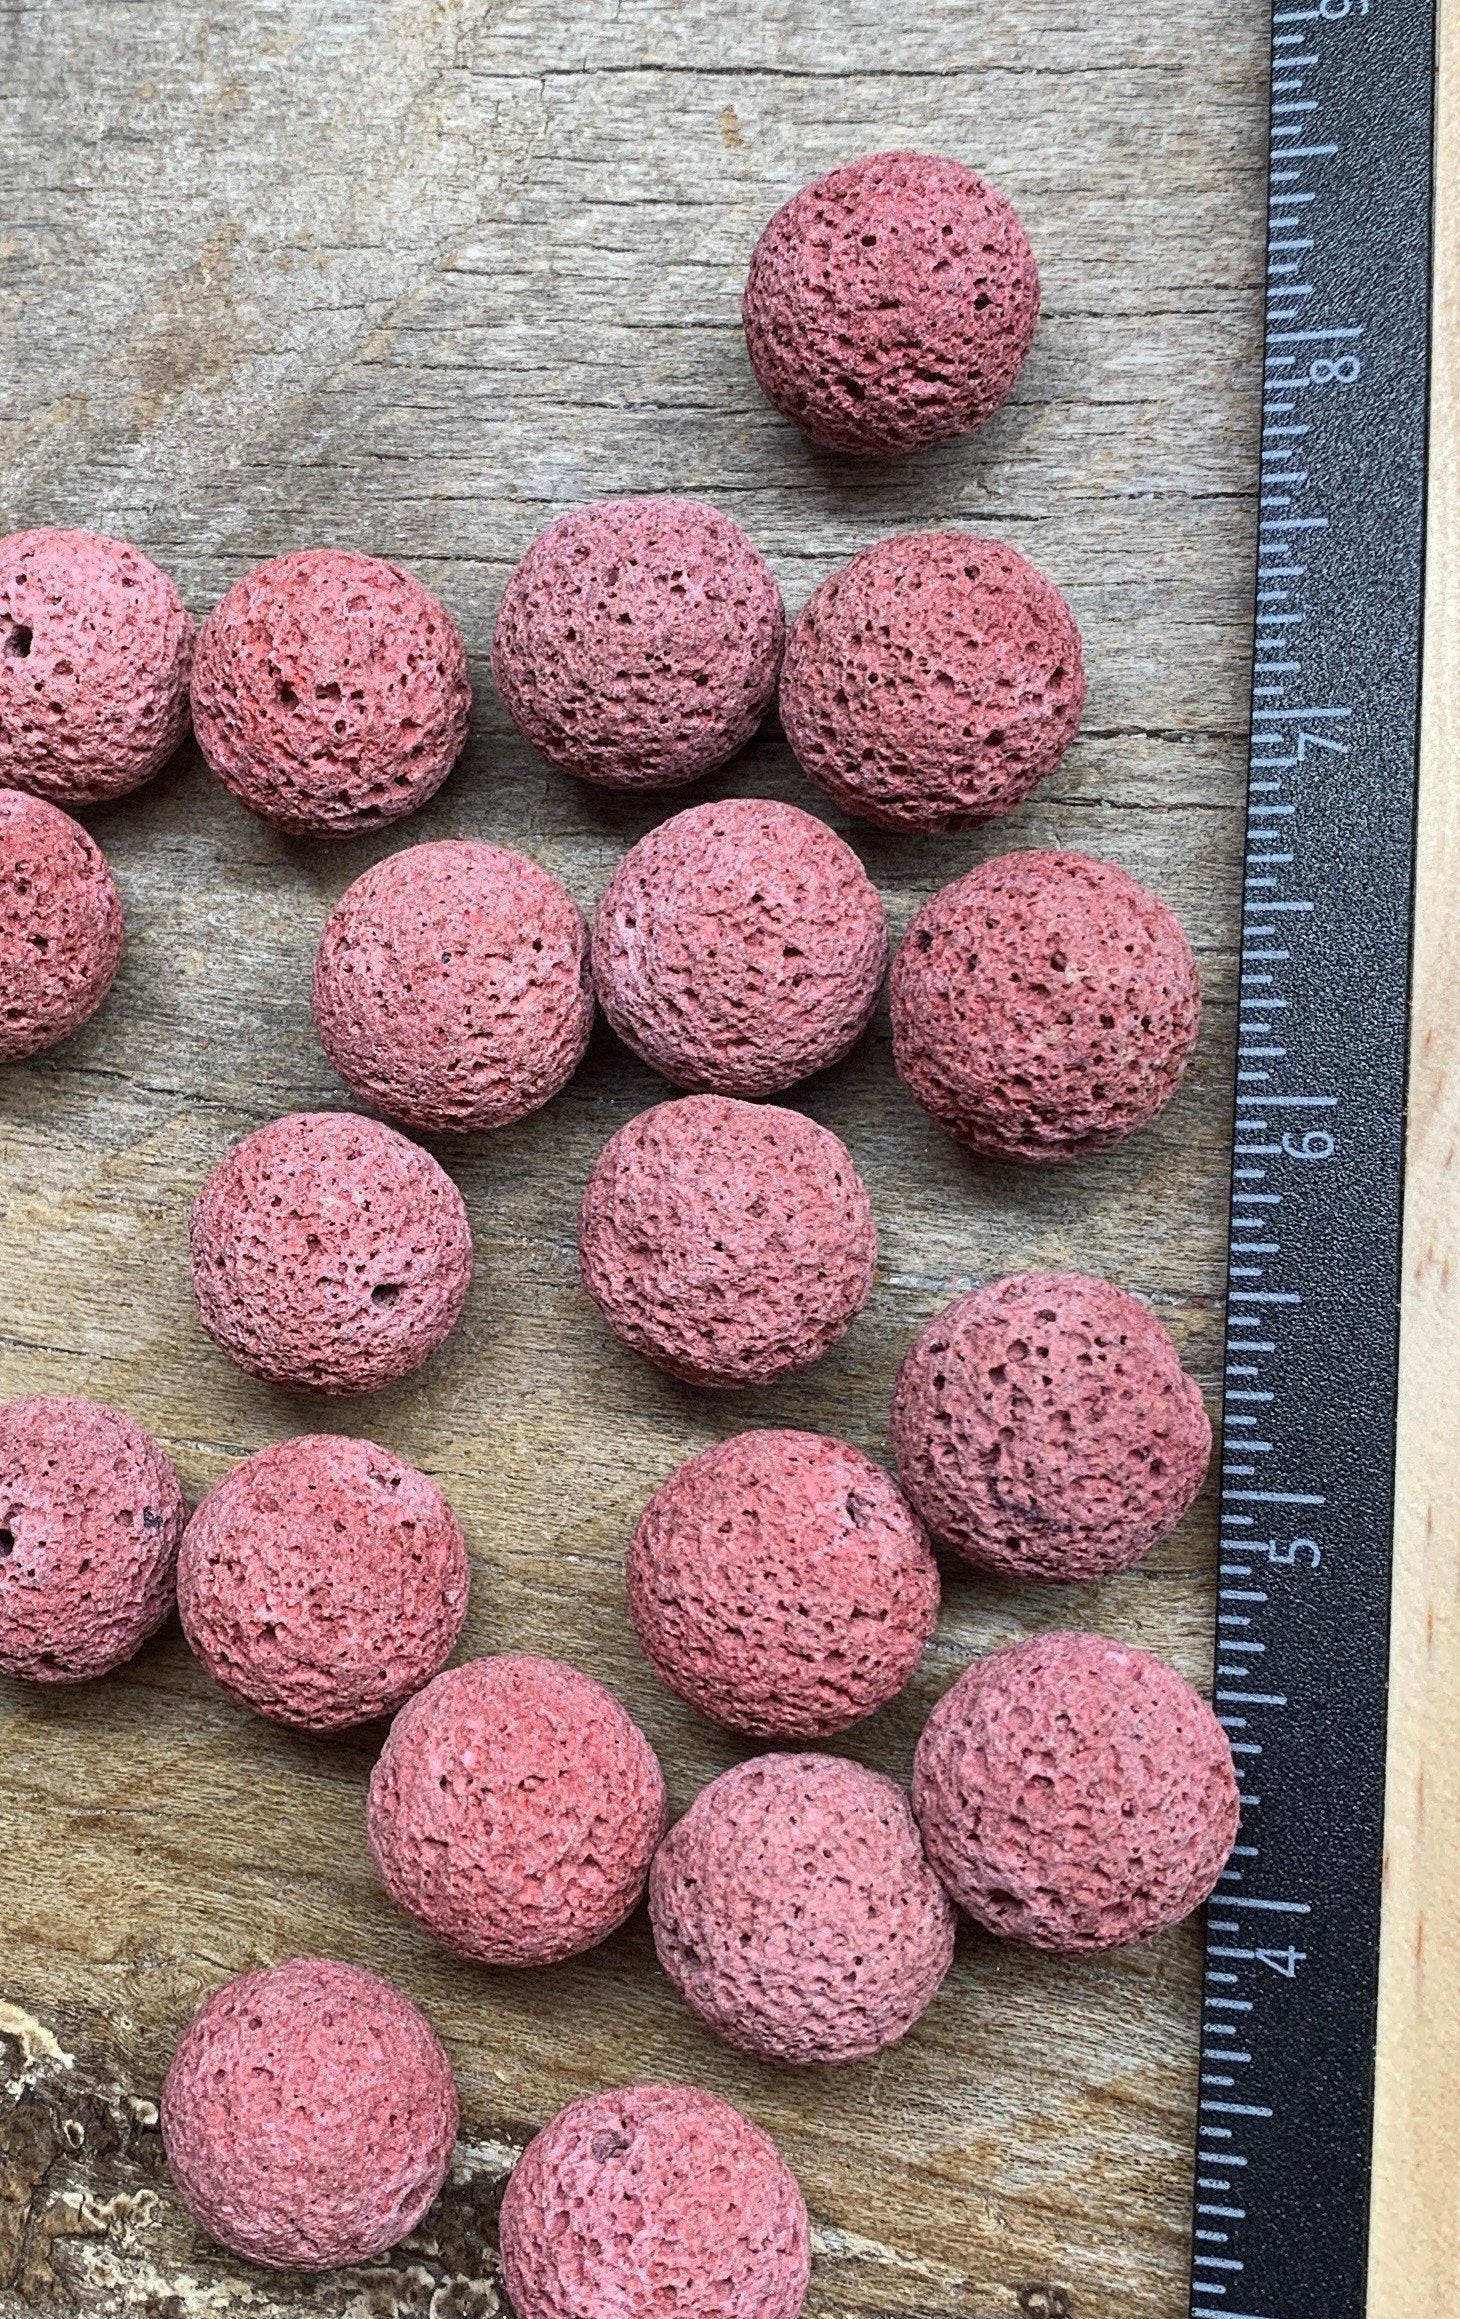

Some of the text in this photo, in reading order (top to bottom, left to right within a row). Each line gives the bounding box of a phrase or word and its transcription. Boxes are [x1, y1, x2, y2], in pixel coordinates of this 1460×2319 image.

[1310, 355, 1363, 386] 8
[1297, 732, 1349, 763] 7
[1281, 1128, 1336, 1162] 6
[1267, 1536, 1321, 1569] 5
[1255, 1945, 1307, 1978] 4
